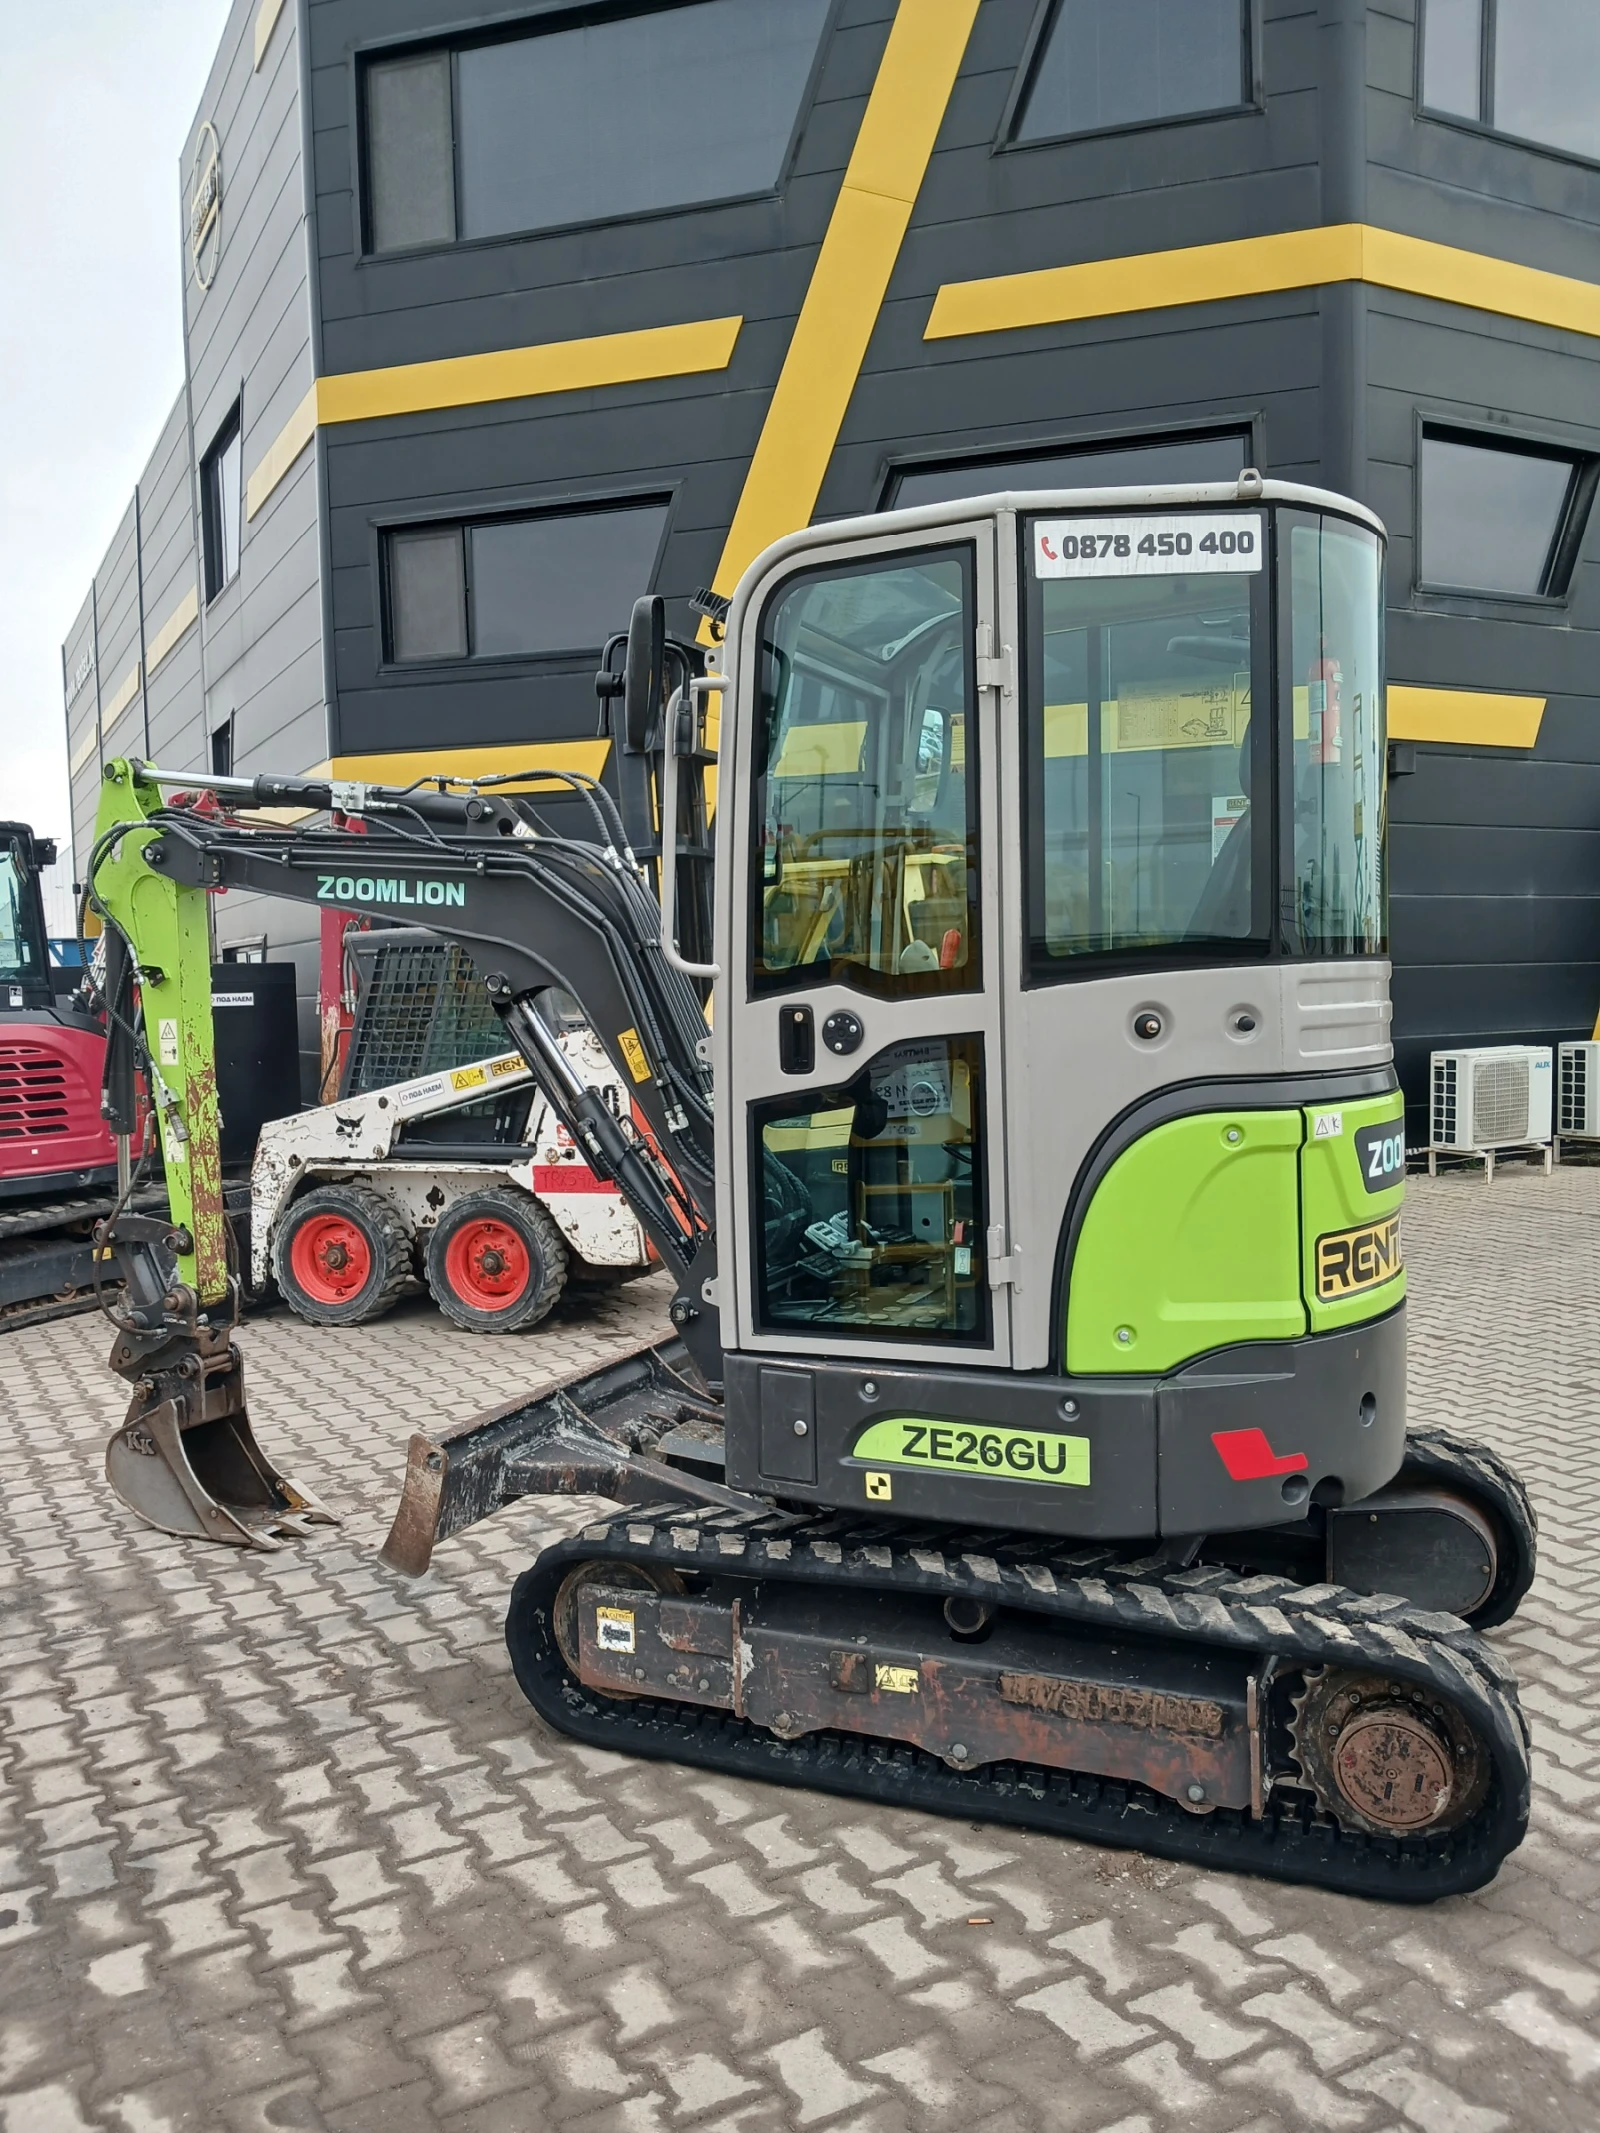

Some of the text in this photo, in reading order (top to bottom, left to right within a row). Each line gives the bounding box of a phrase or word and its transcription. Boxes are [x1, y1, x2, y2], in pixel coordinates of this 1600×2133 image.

[1062, 530, 1254, 559] 0878 450 400
[316, 875, 465, 907] ZOOMLION
[1534, 1060, 1551, 1069] AUX
[408, 1083, 443, 1100] ПОД НАЕМ
[1368, 1131, 1405, 1178] ZOO
[902, 1424, 1067, 1475] ZE26GU
